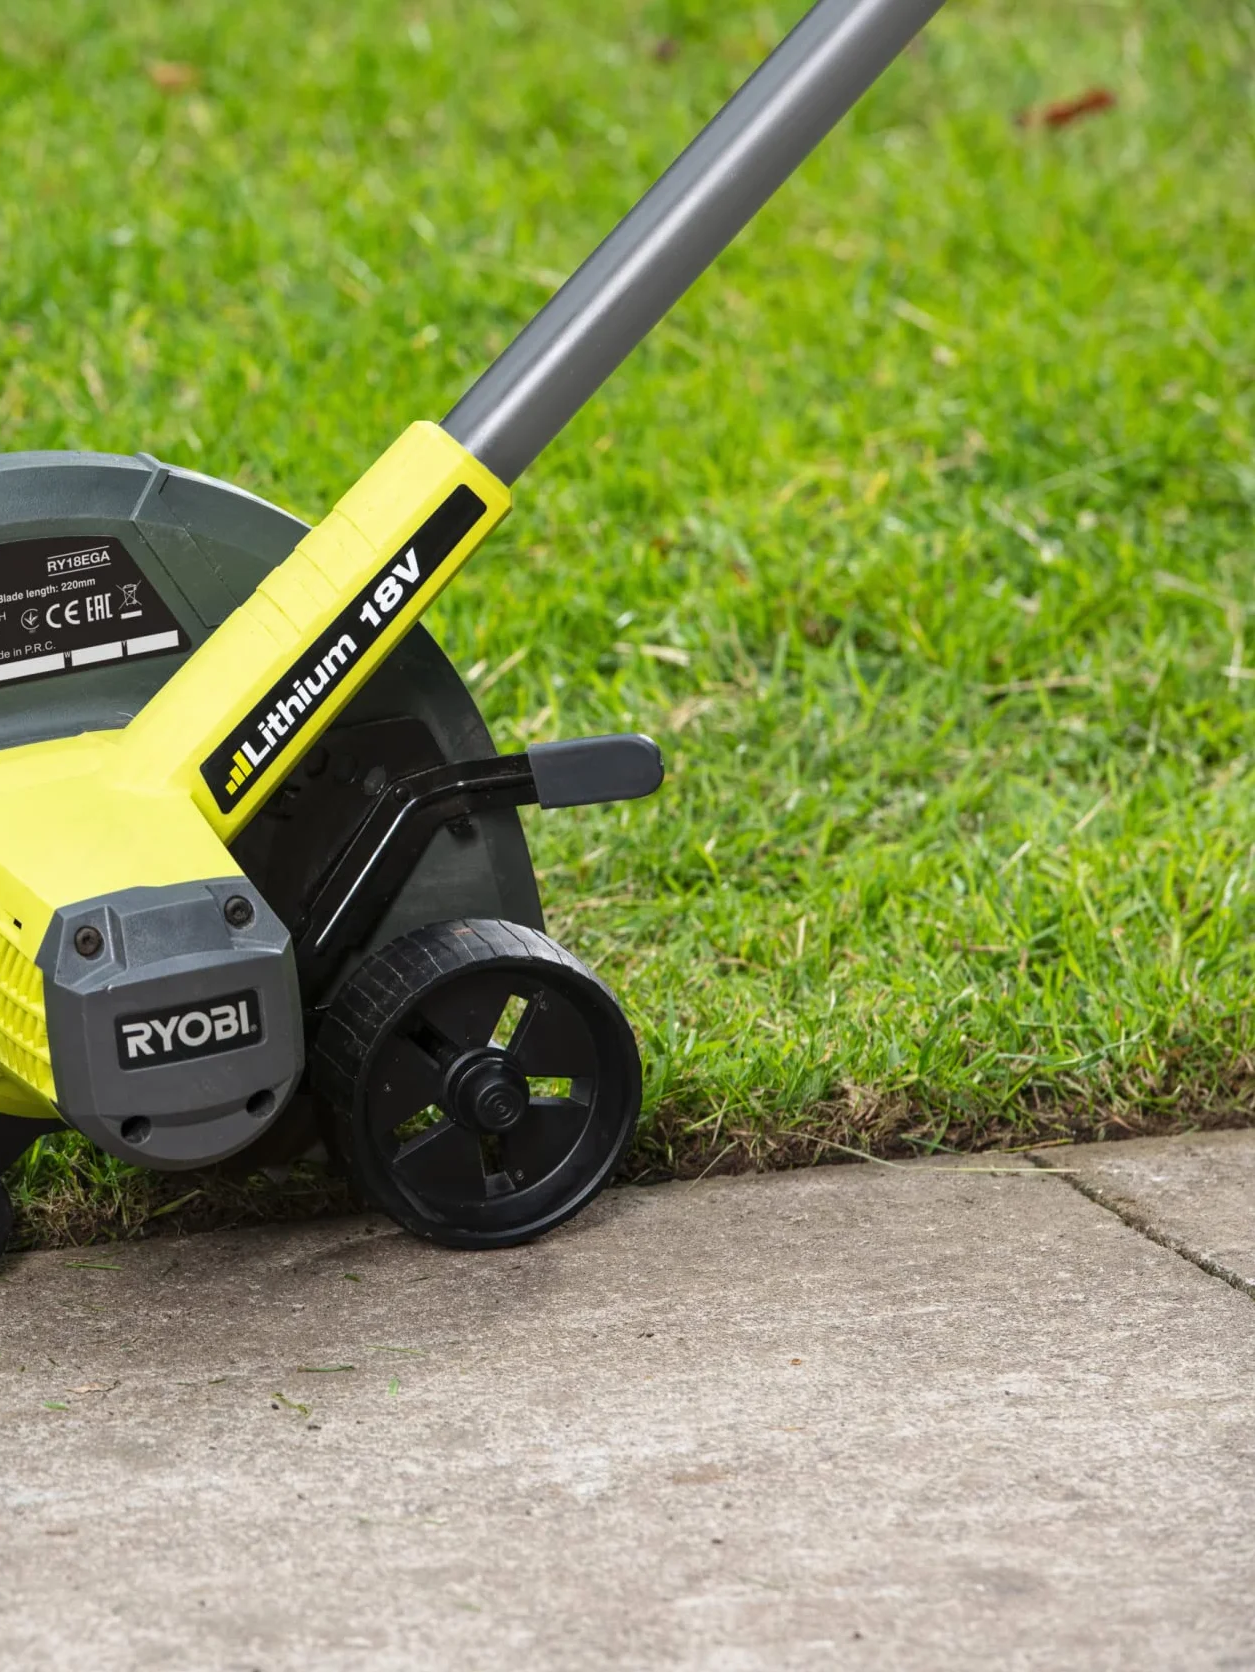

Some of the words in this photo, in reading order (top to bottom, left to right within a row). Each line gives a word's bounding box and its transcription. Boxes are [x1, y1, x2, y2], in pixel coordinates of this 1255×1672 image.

[47, 550, 111, 573] RY18EGA
[26, 585, 59, 600] length:
[61, 578, 96, 591] 220mm
[13, 646, 22, 656] in
[24, 641, 56, 655] P.R.C.
[240, 633, 358, 767] Lithium
[359, 547, 421, 628] 18V
[122, 1001, 251, 1058] RYOBI
